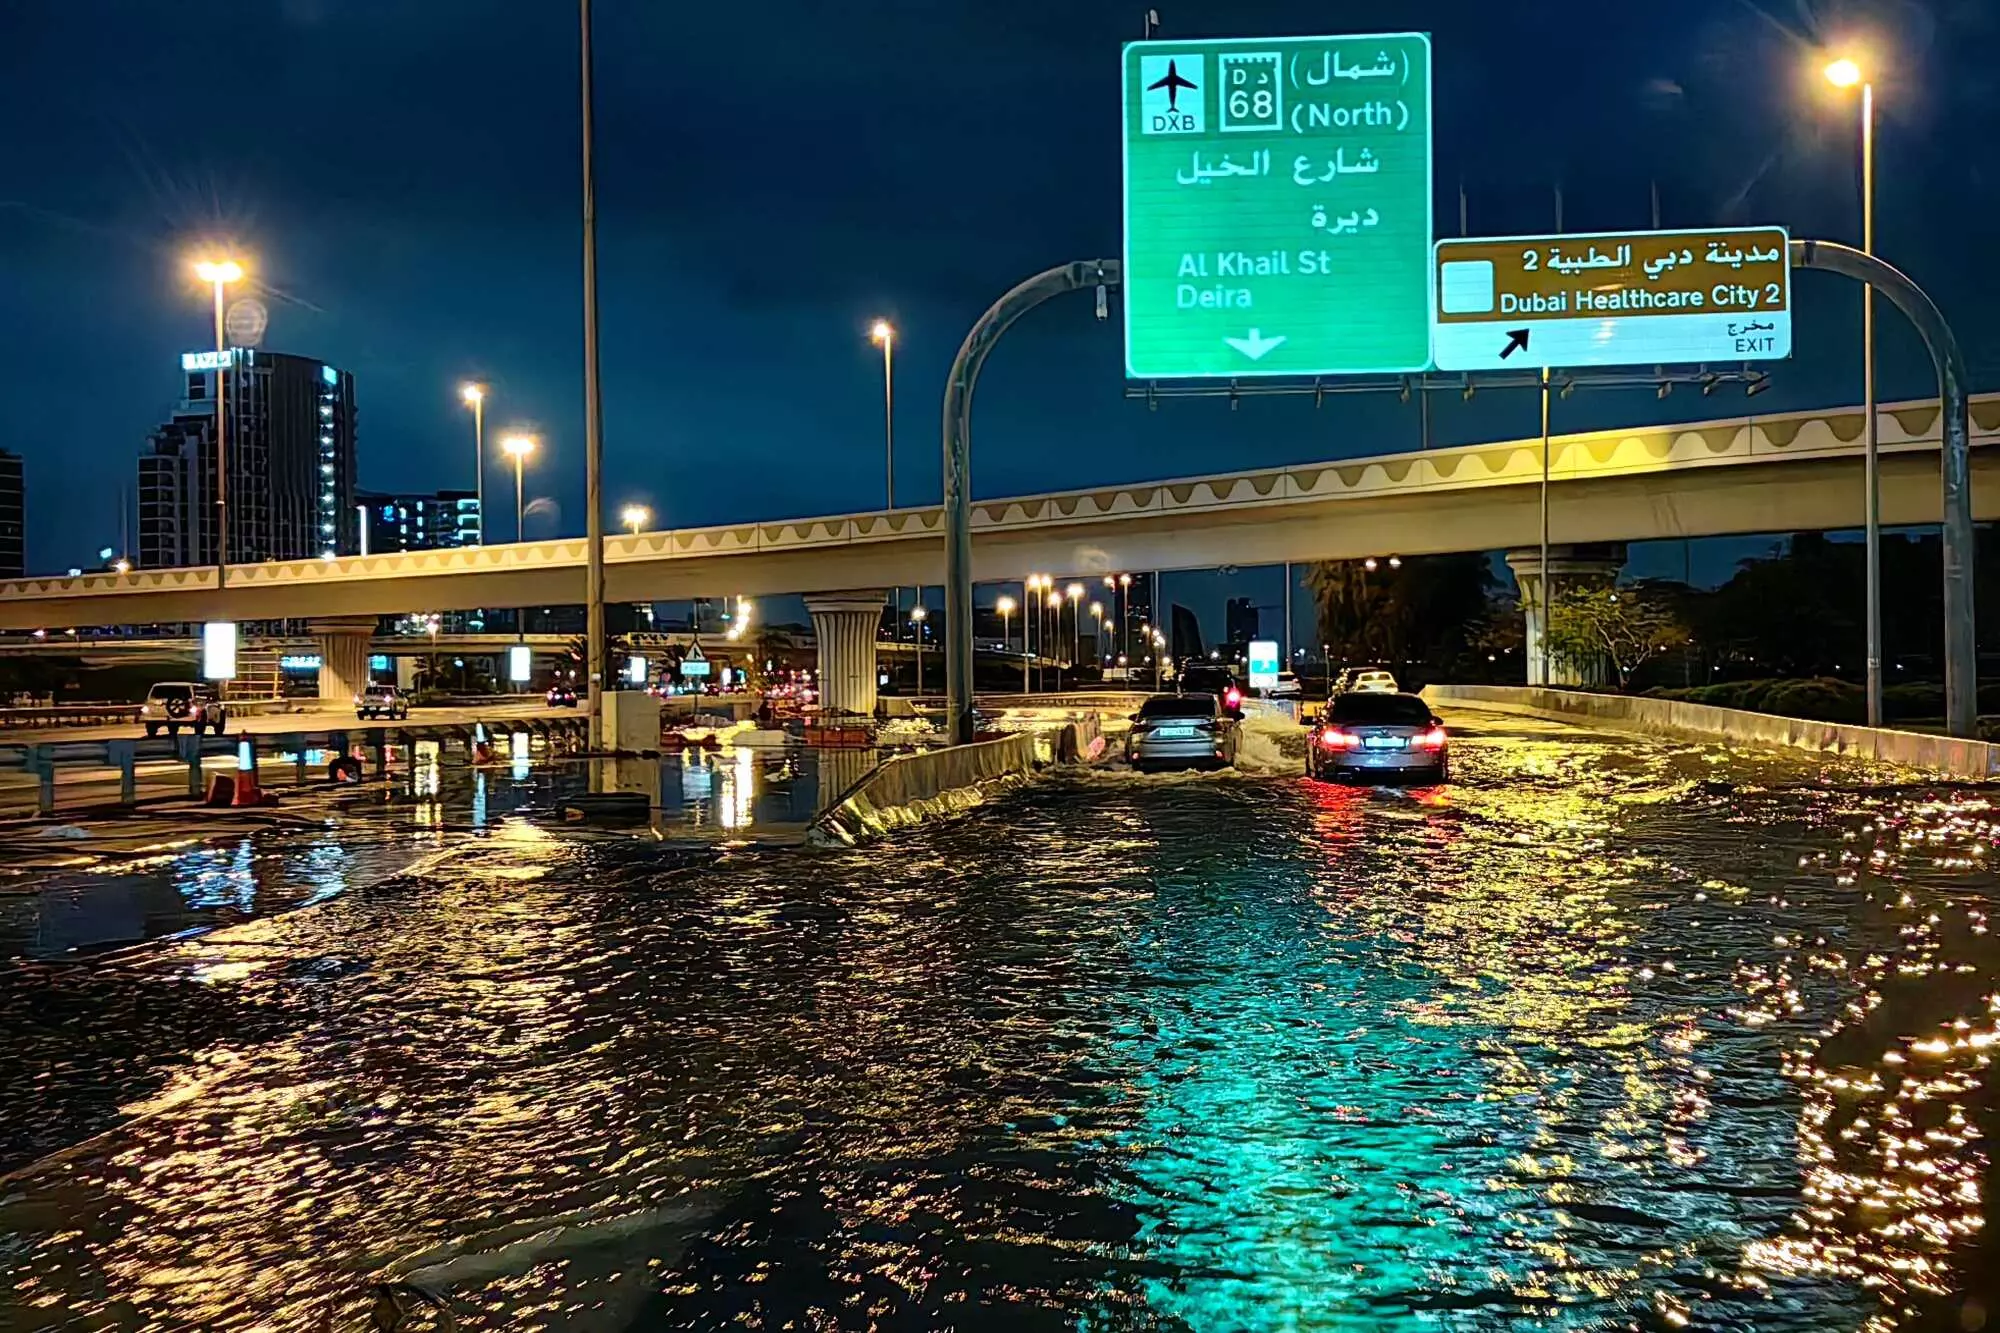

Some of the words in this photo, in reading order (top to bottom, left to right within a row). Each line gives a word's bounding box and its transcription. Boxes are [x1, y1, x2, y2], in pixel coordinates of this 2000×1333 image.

[1233, 69, 1247, 85] D
[1229, 89, 1273, 119] 68
[1291, 100, 1409, 134] (North)
[1152, 114, 1196, 133] DXB
[1176, 148, 1271, 184] الخيل
[1293, 147, 1379, 186] شارع
[1311, 204, 1379, 234] ديرة
[1178, 253, 1208, 277] Al
[1217, 251, 1290, 276] Khail
[1297, 250, 1332, 275] St
[1523, 251, 1539, 272] 2
[1547, 244, 1632, 276] الطبية
[1643, 248, 1693, 281] دبي
[1705, 241, 1780, 269] مدينة
[1176, 284, 1253, 309] Deira
[1500, 291, 1567, 314] Dubai
[1576, 287, 1704, 311] Healthcare
[1711, 284, 1760, 309] City
[1766, 283, 1780, 303] 2
[1727, 320, 1775, 336] مخرج
[1734, 338, 1775, 353] EXIT
